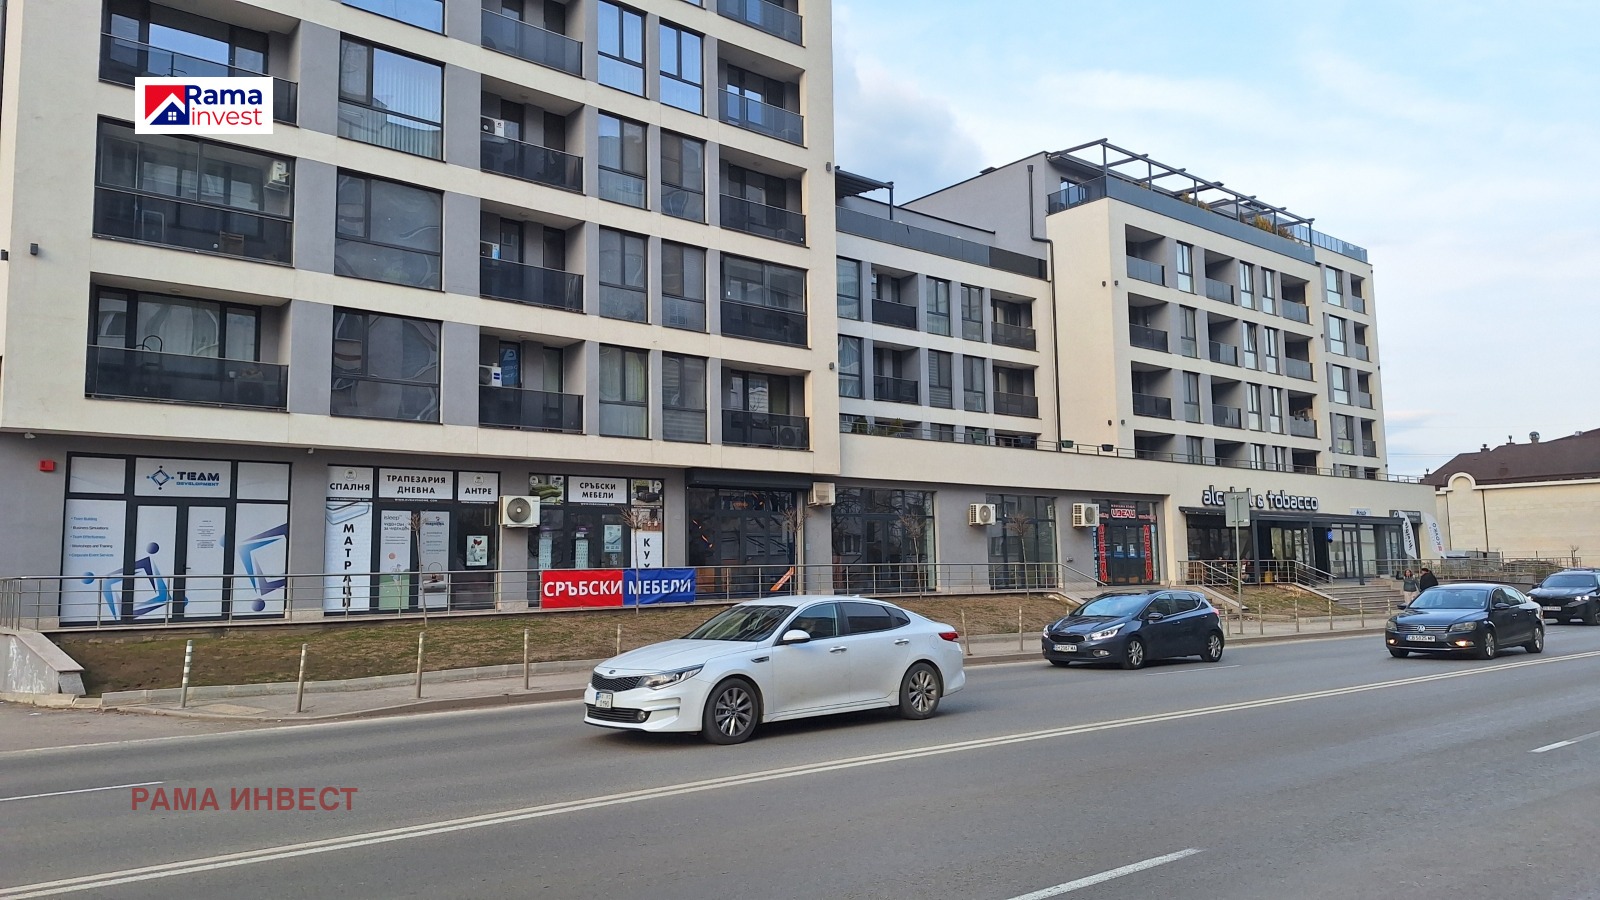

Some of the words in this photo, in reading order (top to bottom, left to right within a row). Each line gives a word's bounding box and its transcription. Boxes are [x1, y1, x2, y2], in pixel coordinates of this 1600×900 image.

[177, 471, 220, 482] TEAM
[386, 475, 446, 484] ТРАПЕЗАРИЯ
[330, 482, 370, 492] СПАЛНЯ
[397, 486, 436, 494] ДНЕВНА
[580, 482, 616, 490] СРЪБСКИ
[1202, 485, 1254, 507] alcl
[1257, 494, 1264, 508] &
[1266, 490, 1318, 510] tobacco
[544, 580, 622, 597] СРЪБСКИ
[628, 578, 691, 595] МЕБЕЛИ
